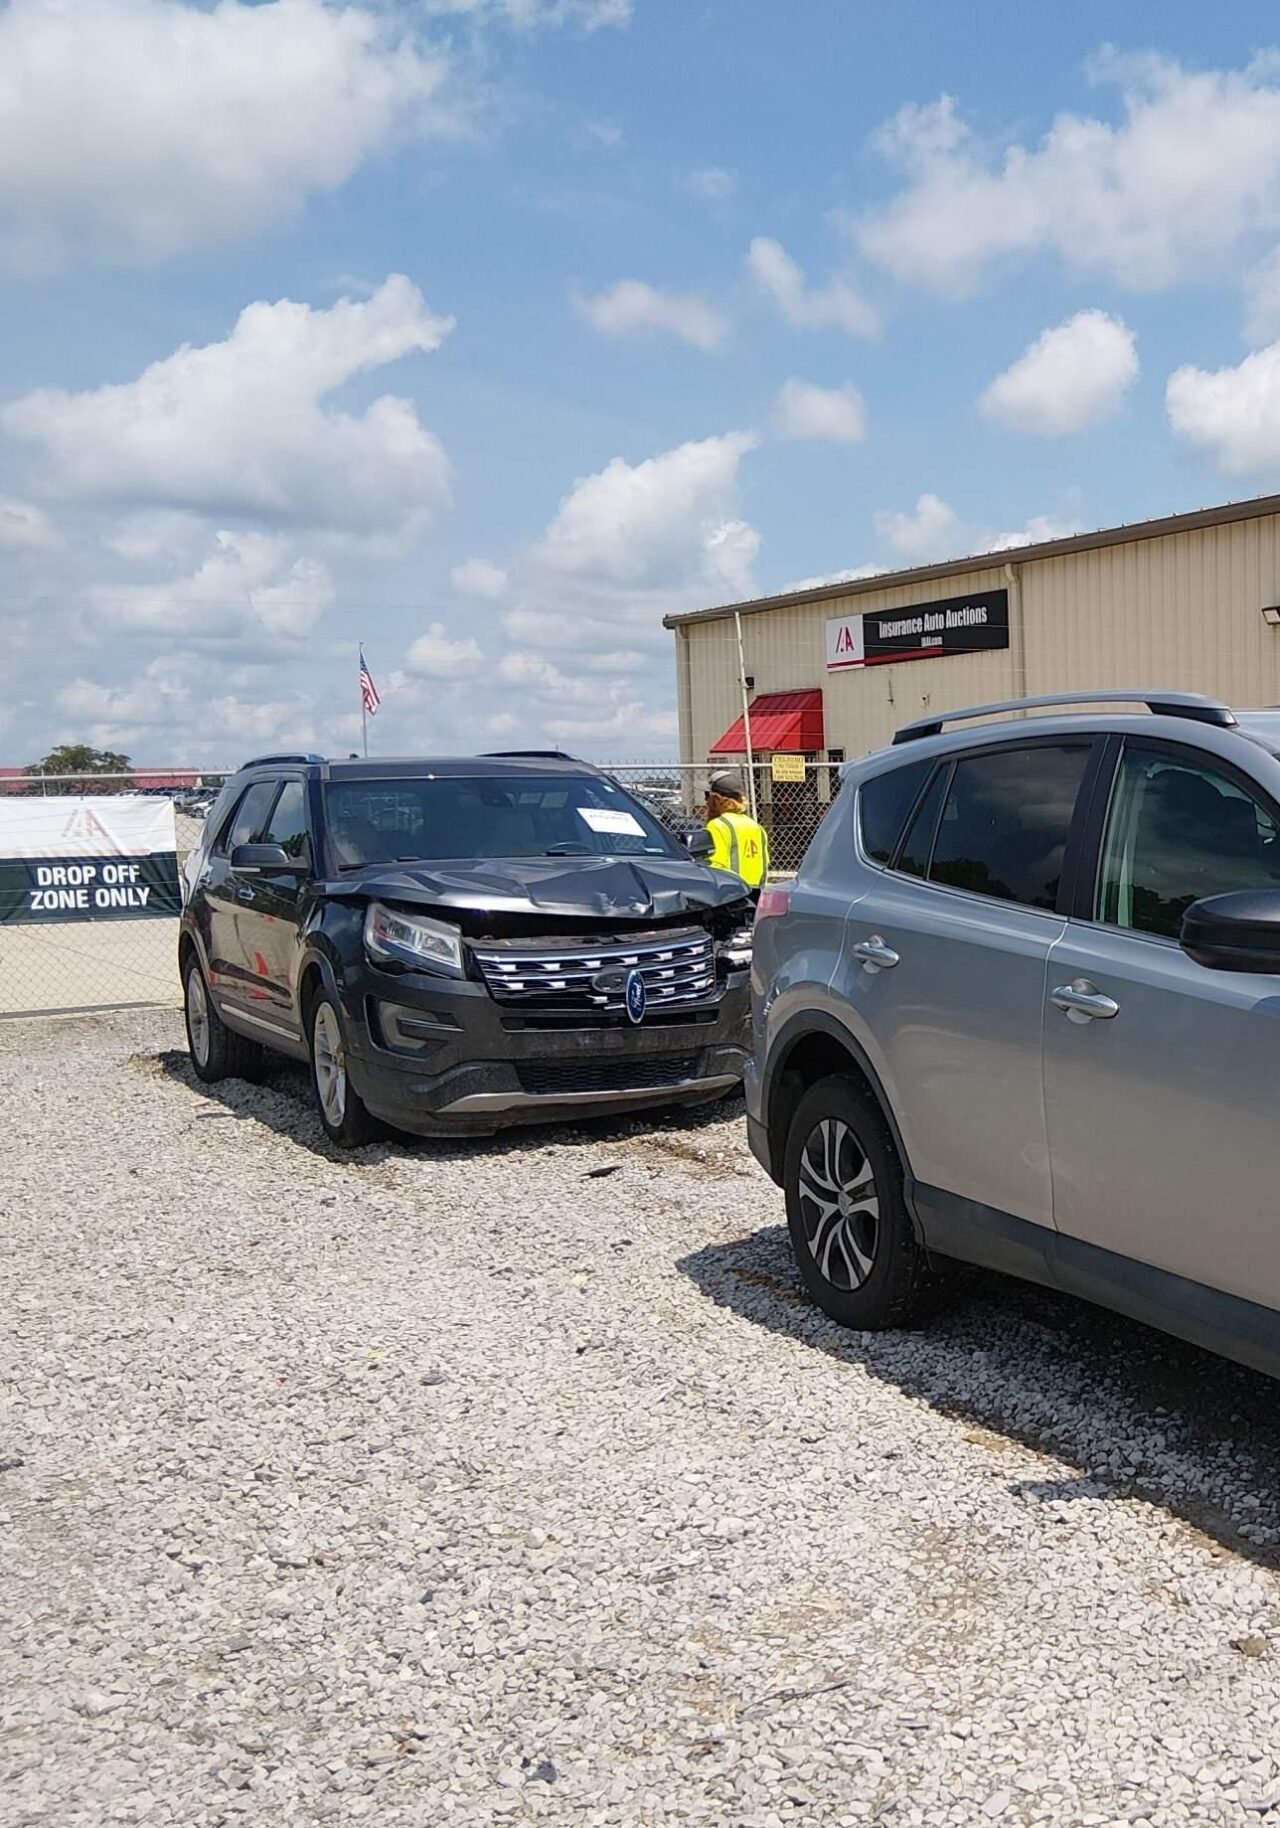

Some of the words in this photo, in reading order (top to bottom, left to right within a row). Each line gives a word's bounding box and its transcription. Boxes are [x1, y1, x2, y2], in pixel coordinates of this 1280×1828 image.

[879, 618, 923, 639] Insurance
[924, 612, 945, 631] Auto
[946, 605, 988, 628] Auctions
[37, 866, 96, 886] DROP
[102, 865, 140, 883] OFF
[30, 889, 90, 910] ZONE
[95, 887, 150, 907] ONLY
